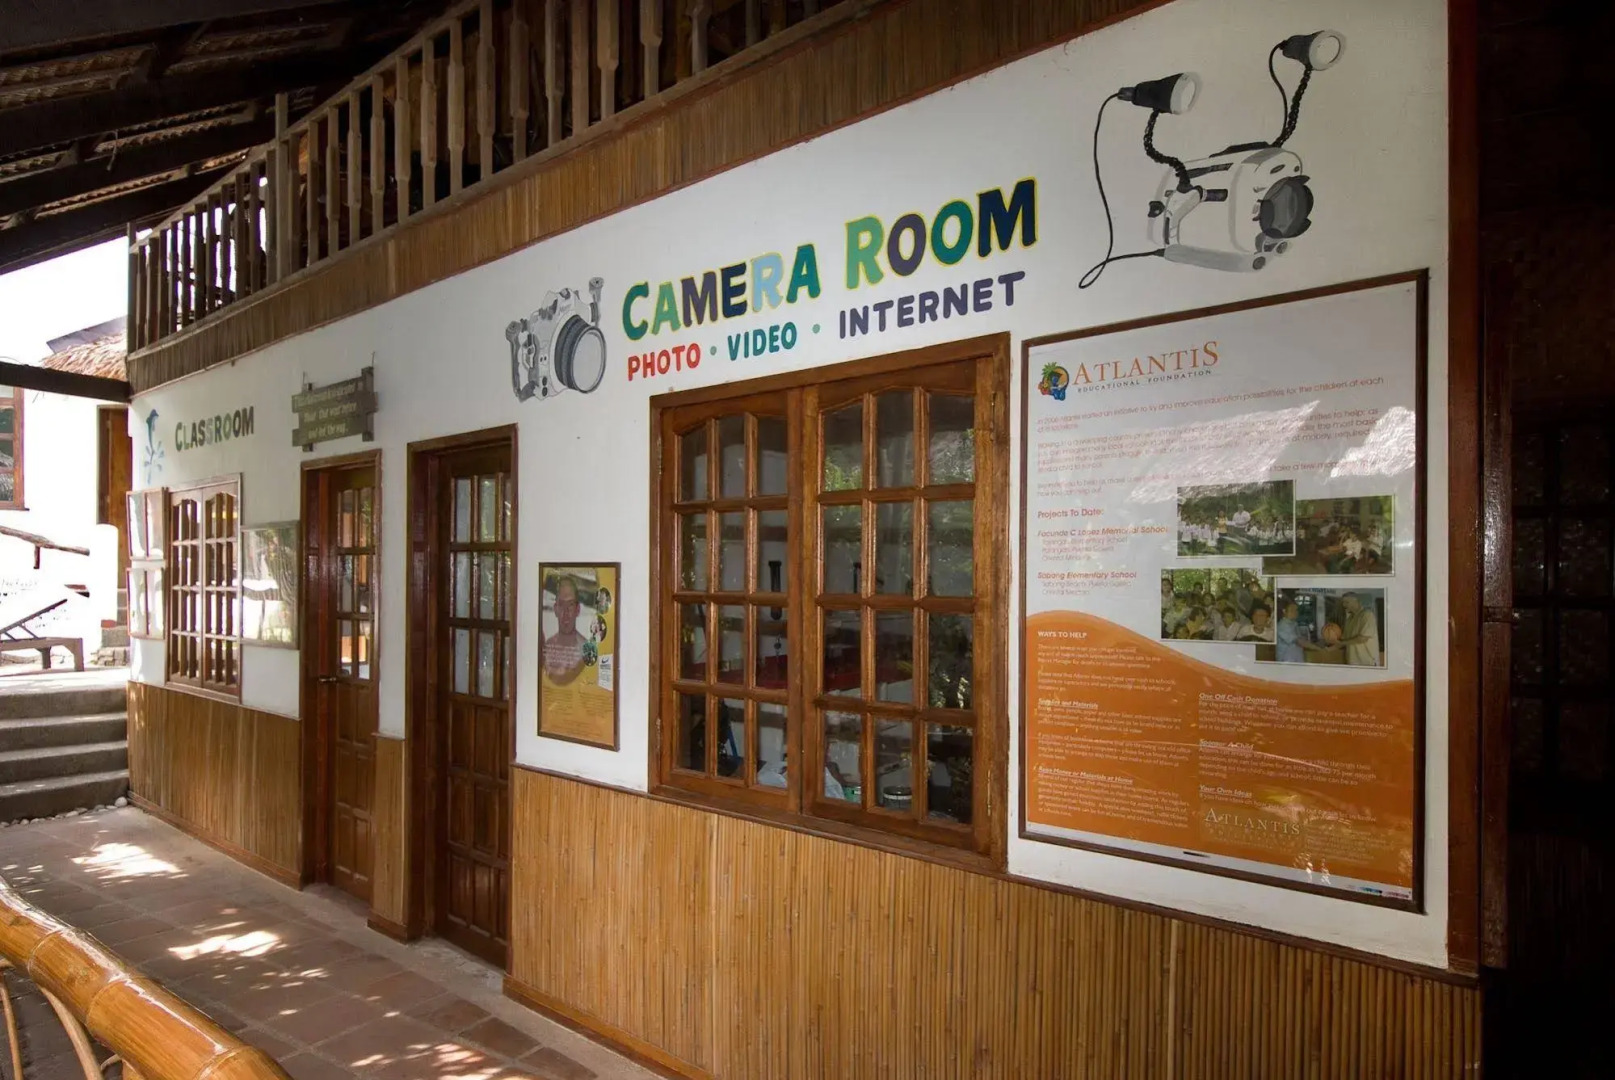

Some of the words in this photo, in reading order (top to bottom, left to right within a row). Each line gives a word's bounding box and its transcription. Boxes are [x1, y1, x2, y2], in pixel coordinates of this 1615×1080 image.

[622, 243, 821, 341] CAMERA
[845, 176, 1038, 290] ROOM
[627, 342, 701, 381] PHOTO
[727, 321, 798, 362] VIDEO
[839, 270, 1026, 339] INTERNET
[1077, 380, 1140, 393] EDUCATIONAL
[1147, 369, 1212, 383] FOUNDATION
[1299, 386, 1312, 394] the
[1314, 382, 1348, 392] children
[1360, 376, 1384, 386] each
[175, 406, 254, 452] CLASSROOM
[1317, 422, 1330, 430] the
[1037, 509, 1068, 520] Projects
[1070, 508, 1079, 517] To
[1081, 507, 1104, 516] Date:
[1140, 524, 1168, 534] School
[1067, 570, 1109, 580] Elementary
[1110, 570, 1137, 579] School
[1037, 630, 1057, 638] WAYS
[1069, 631, 1087, 639] HELP
[1199, 692, 1214, 700] One
[1226, 694, 1244, 702] Cash
[1245, 695, 1278, 705] Donation
[1200, 785, 1217, 793] Your
[1217, 787, 1233, 795] Own
